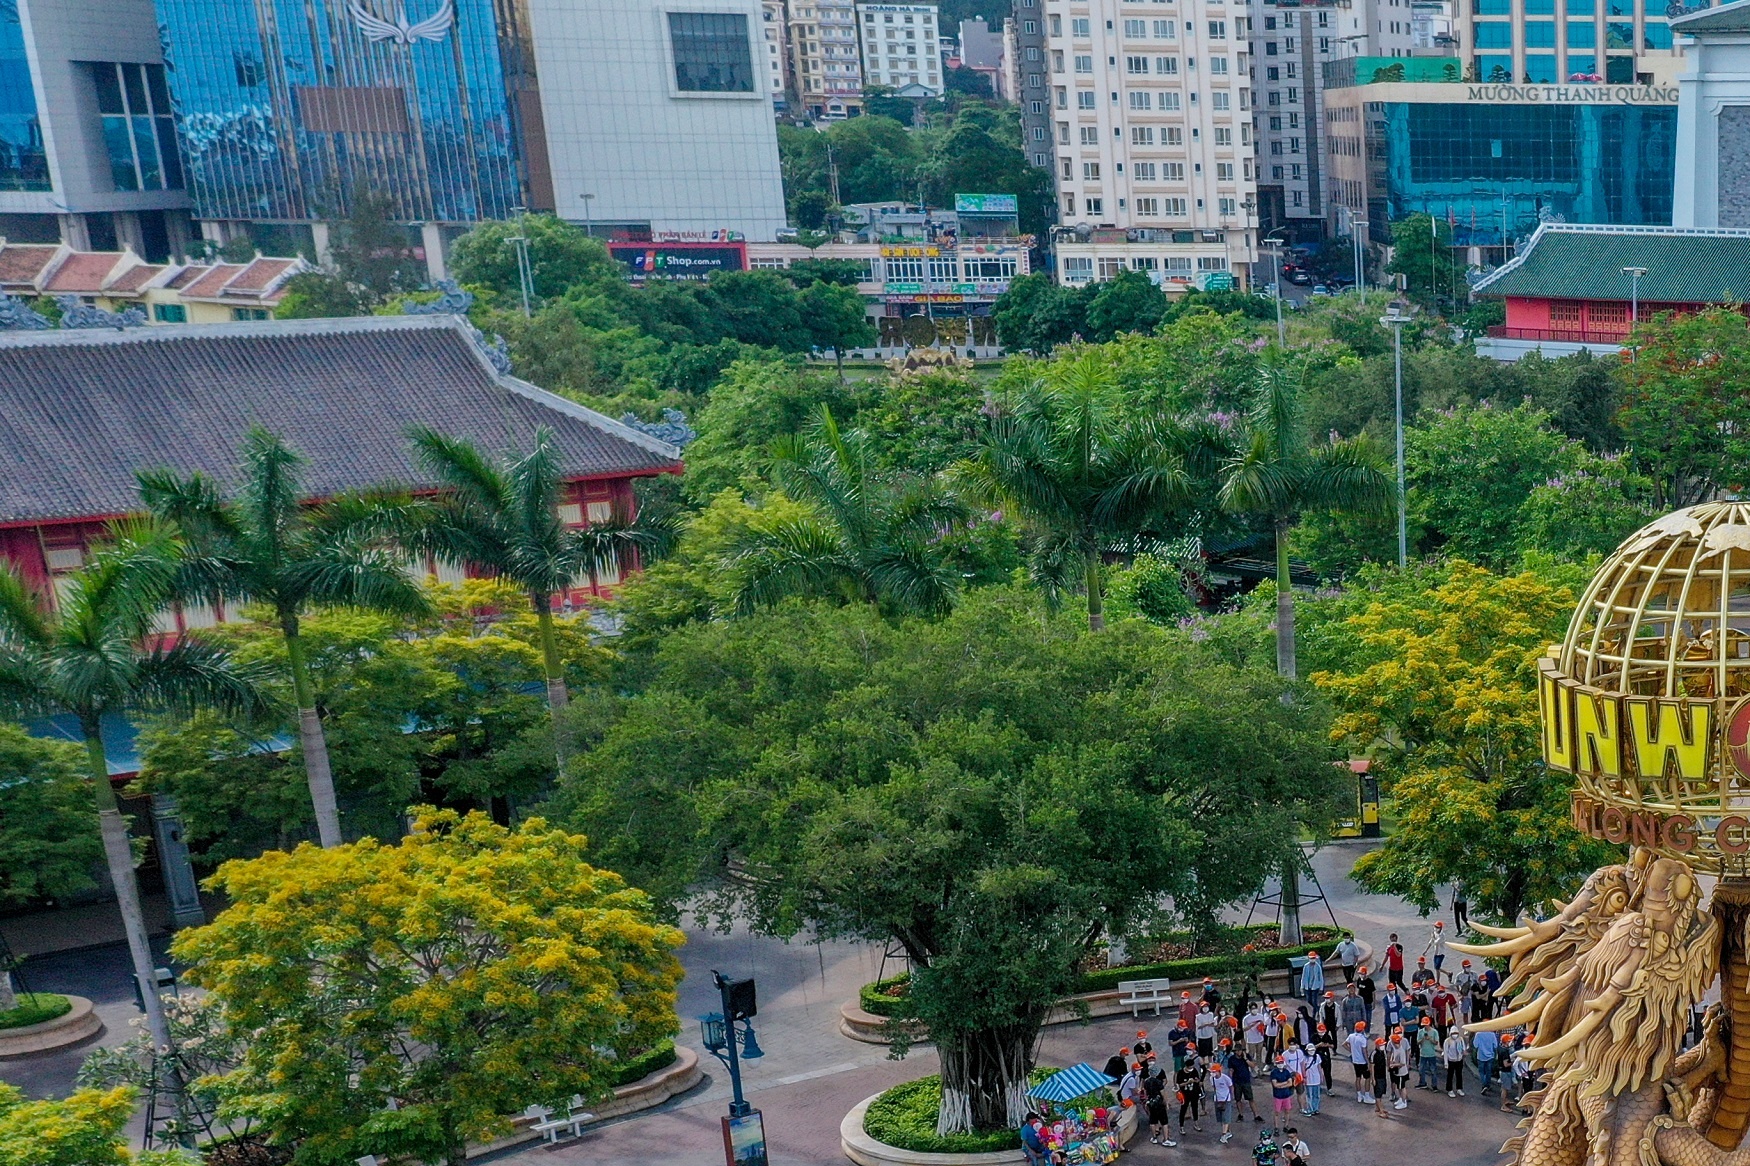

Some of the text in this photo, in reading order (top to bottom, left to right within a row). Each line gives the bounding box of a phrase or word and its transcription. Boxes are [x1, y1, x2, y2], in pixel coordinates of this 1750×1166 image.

[1468, 84, 1539, 101] MƯỜNG
[1542, 87, 1611, 102] THANH
[634, 253, 721, 269] FPT Shop.com.vn
[1571, 792, 1697, 853] ALONG
